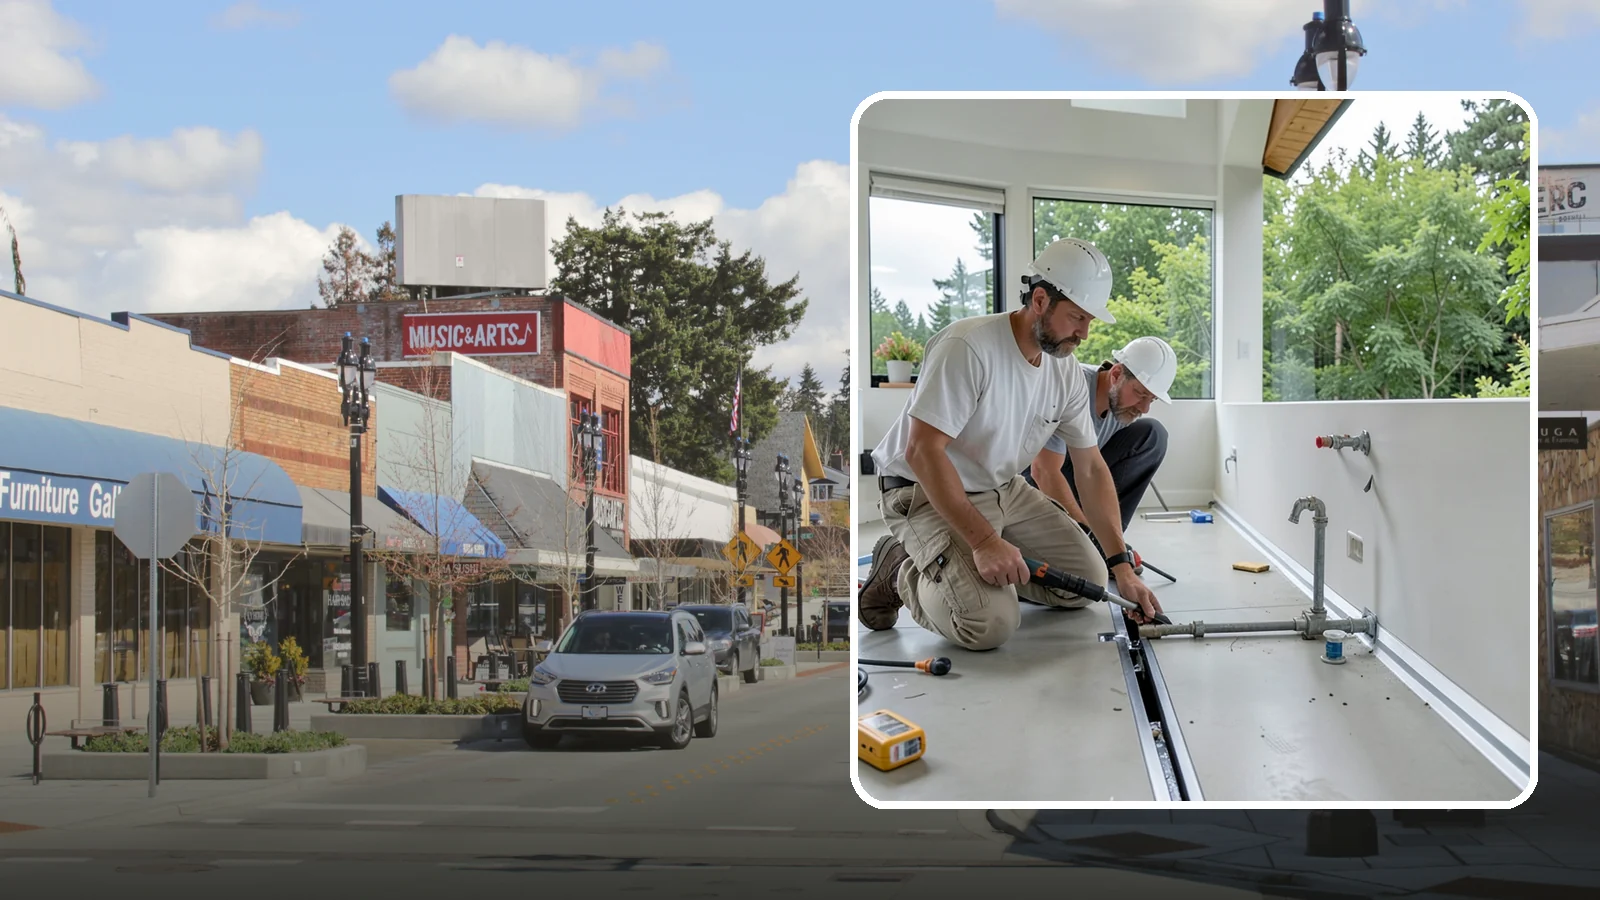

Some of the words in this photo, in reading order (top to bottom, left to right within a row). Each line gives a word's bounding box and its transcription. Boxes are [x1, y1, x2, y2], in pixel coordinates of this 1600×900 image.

[1540, 427, 1577, 437] UGA
[0, 471, 79, 515] Furniture
[89, 482, 121, 519] Gal
[453, 563, 479, 574] SUSHI
